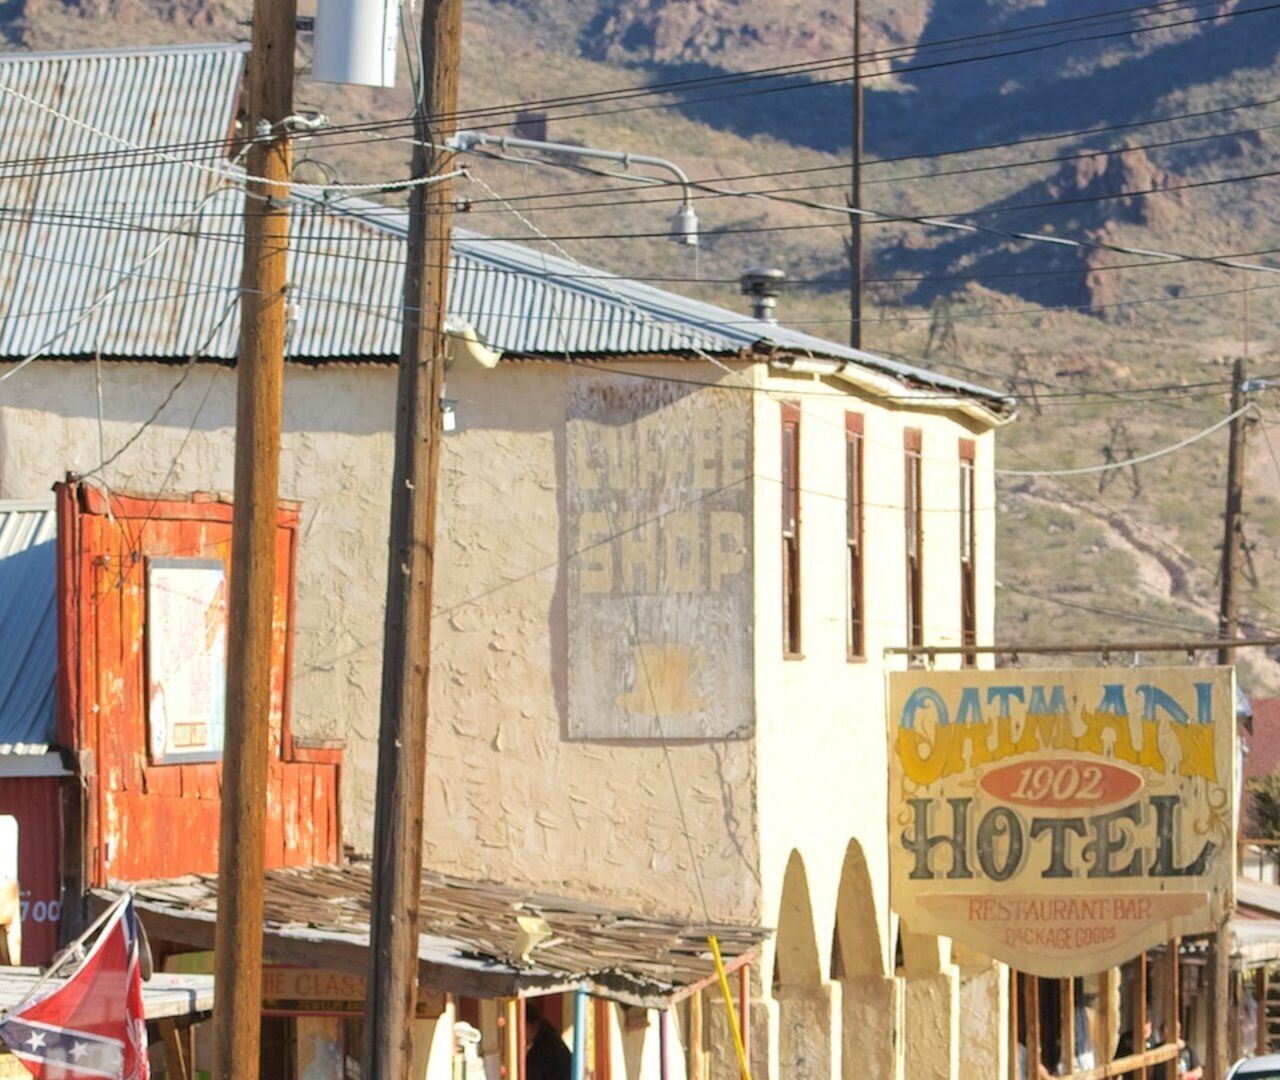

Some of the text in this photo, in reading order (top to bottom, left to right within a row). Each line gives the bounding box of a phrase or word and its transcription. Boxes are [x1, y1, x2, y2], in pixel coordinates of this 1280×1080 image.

[578, 510, 746, 593] SHOP
[895, 682, 1219, 786] OATMAN
[1010, 765, 1104, 801] 1902
[901, 794, 1217, 882] HOTEL
[1004, 924, 1118, 950] PACKAGE GOODS
